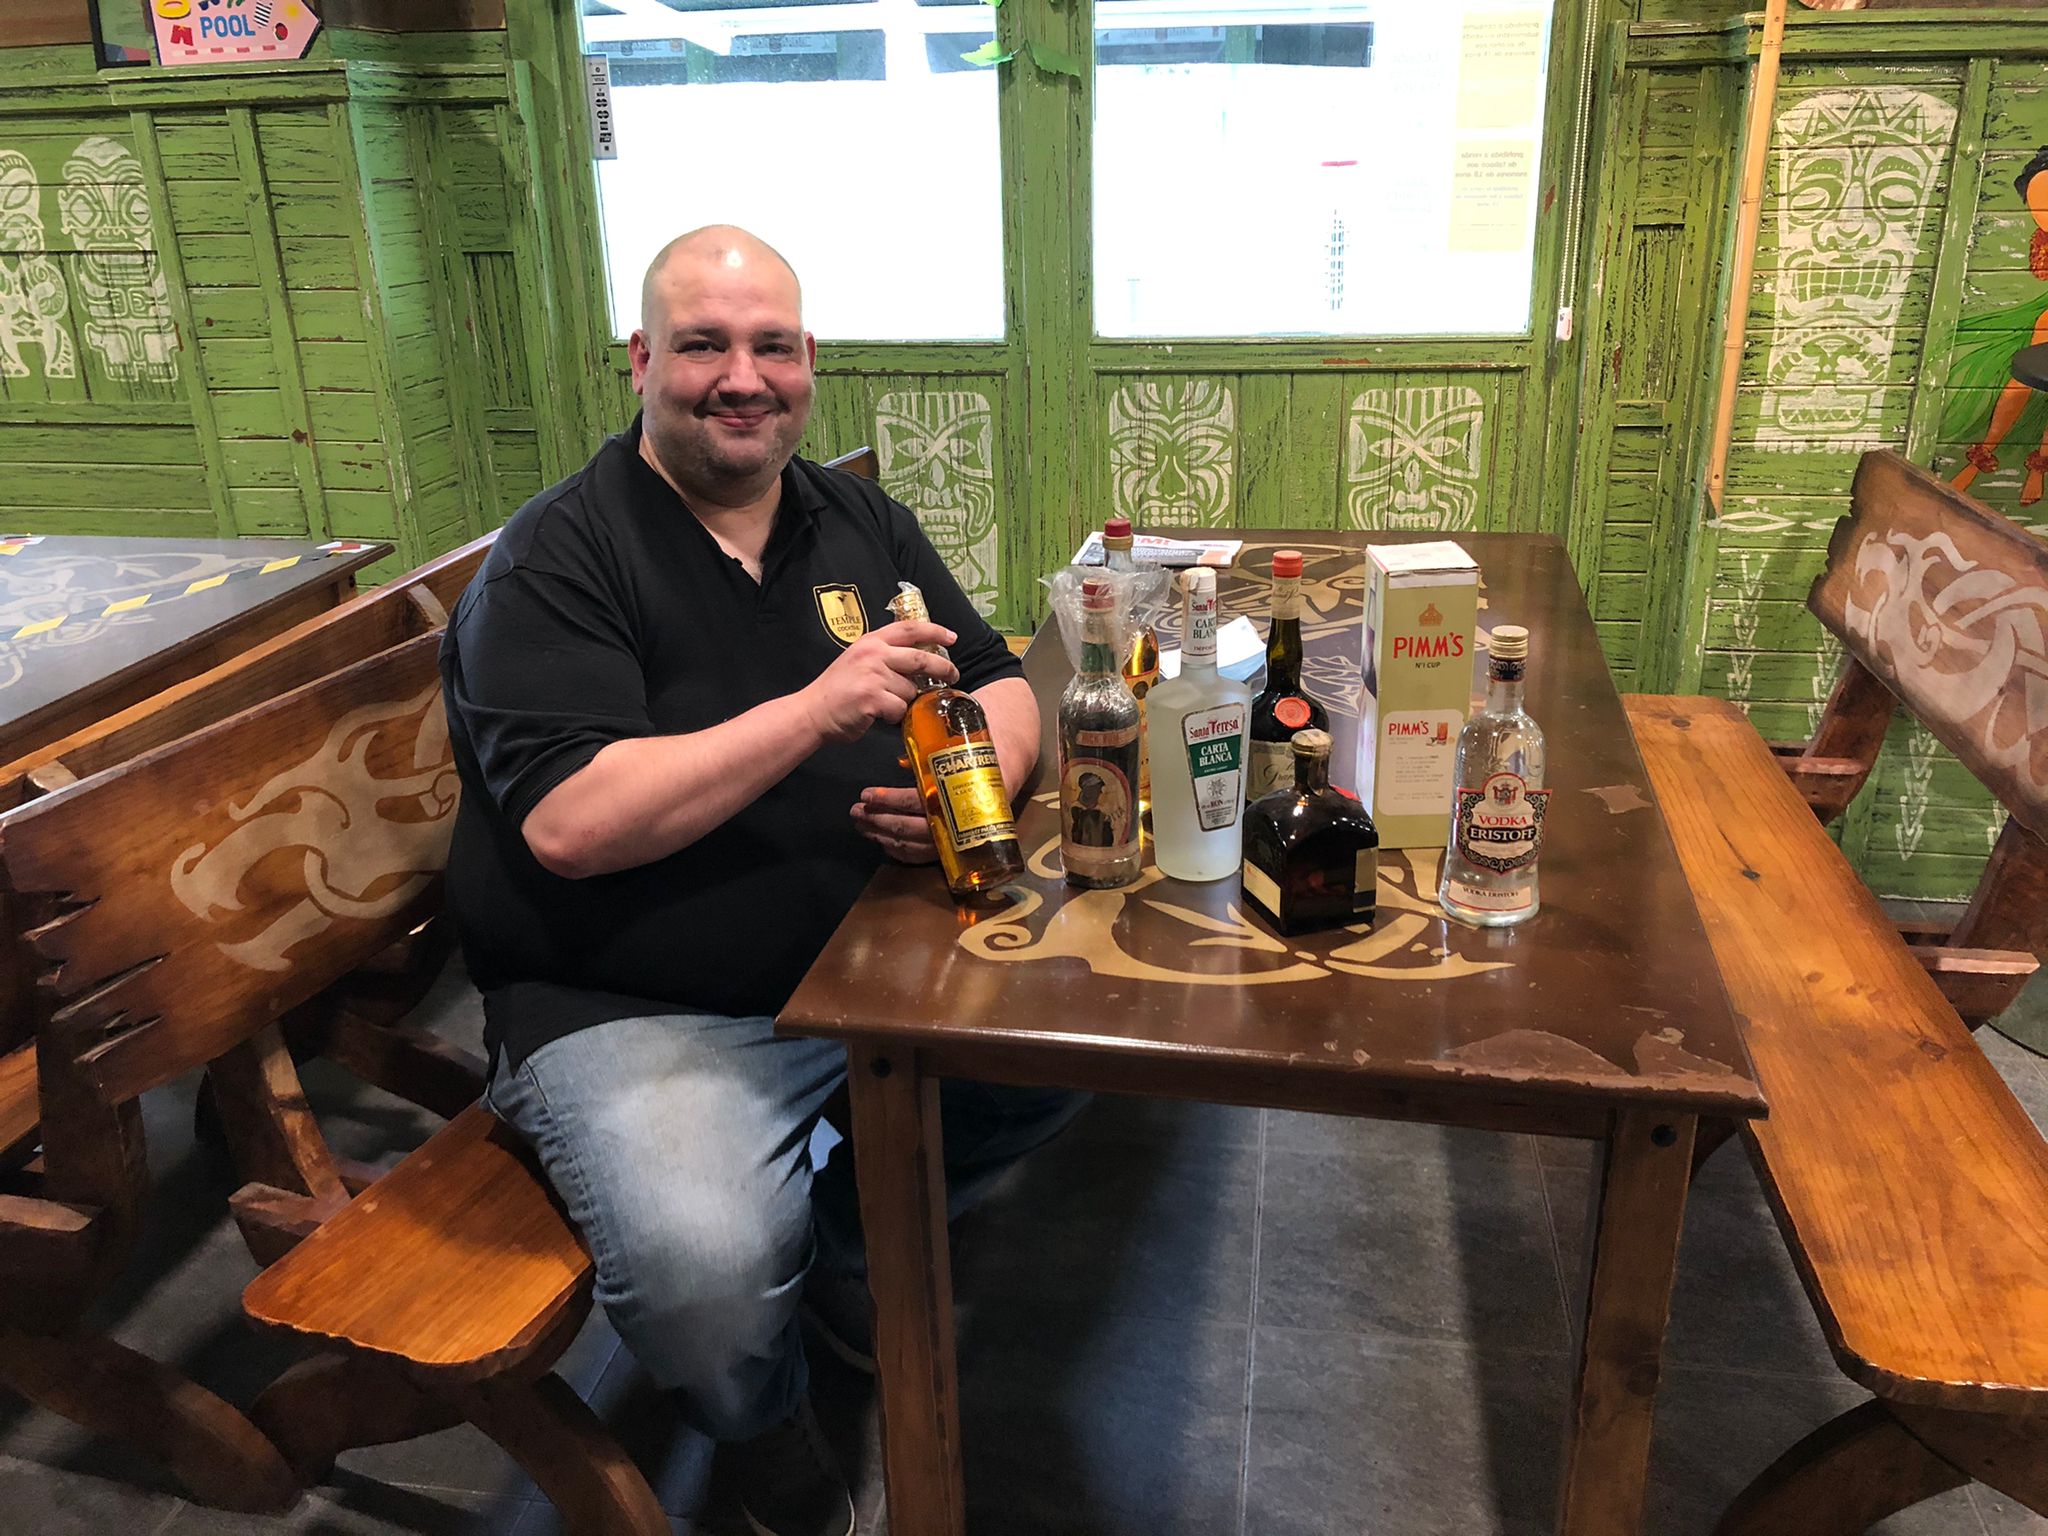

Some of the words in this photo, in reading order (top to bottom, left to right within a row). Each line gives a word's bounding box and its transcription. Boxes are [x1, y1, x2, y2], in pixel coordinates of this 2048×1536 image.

[200, 14, 256, 39] POOL
[1393, 631, 1465, 660] PIMM'S
[1427, 661, 1441, 669] CUP
[1388, 720, 1429, 736] PIMM'S
[1200, 741, 1230, 756] CARTA
[1199, 753, 1233, 767] BLANCA
[1478, 814, 1528, 827] VODKA
[1469, 827, 1535, 842] ERISTOFF
